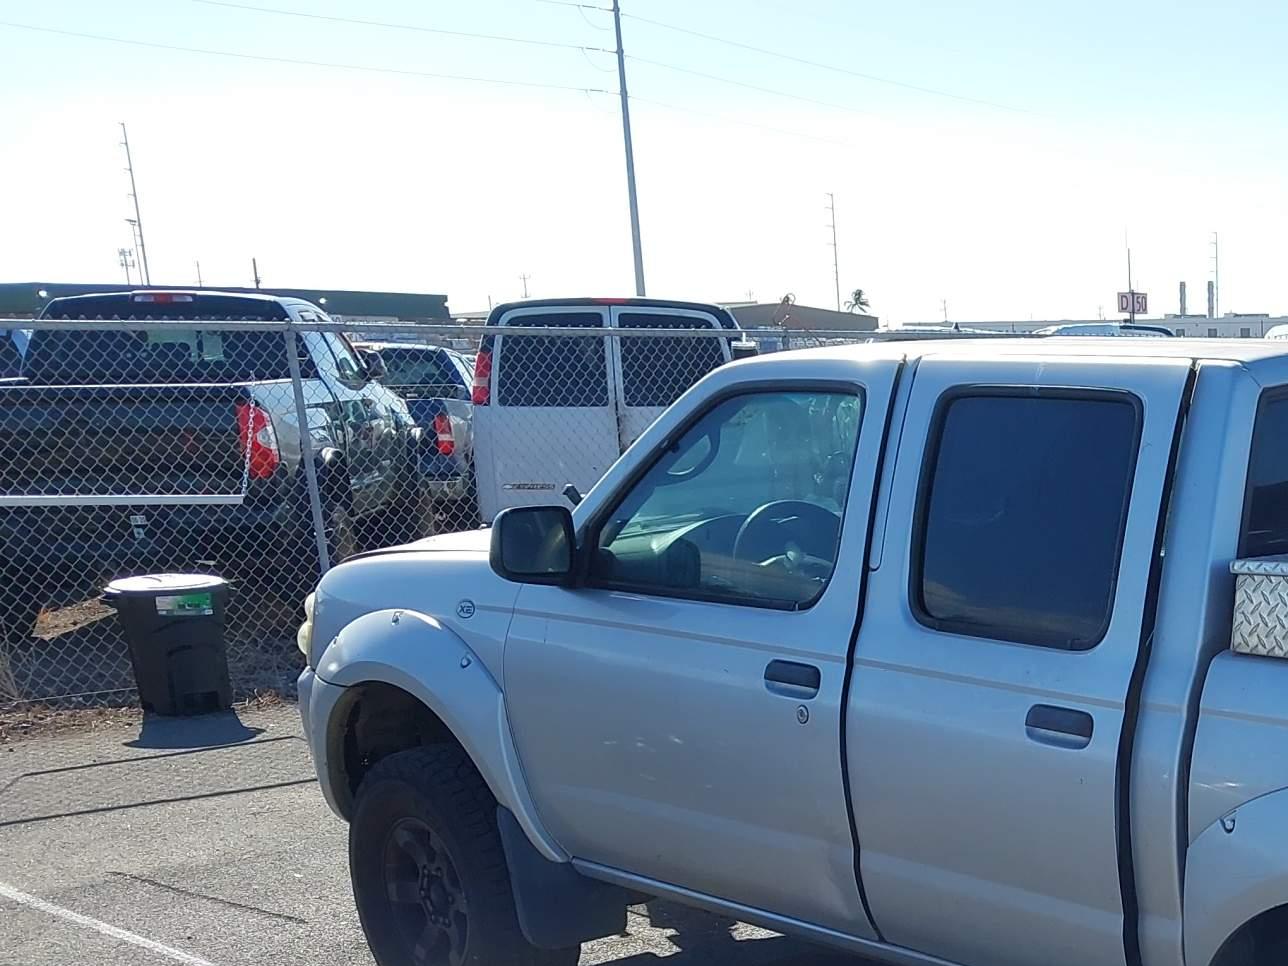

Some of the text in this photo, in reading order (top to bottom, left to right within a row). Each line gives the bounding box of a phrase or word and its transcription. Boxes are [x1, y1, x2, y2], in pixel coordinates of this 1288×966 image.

[1120, 294, 1147, 312] D 50
[459, 604, 473, 614] XE
